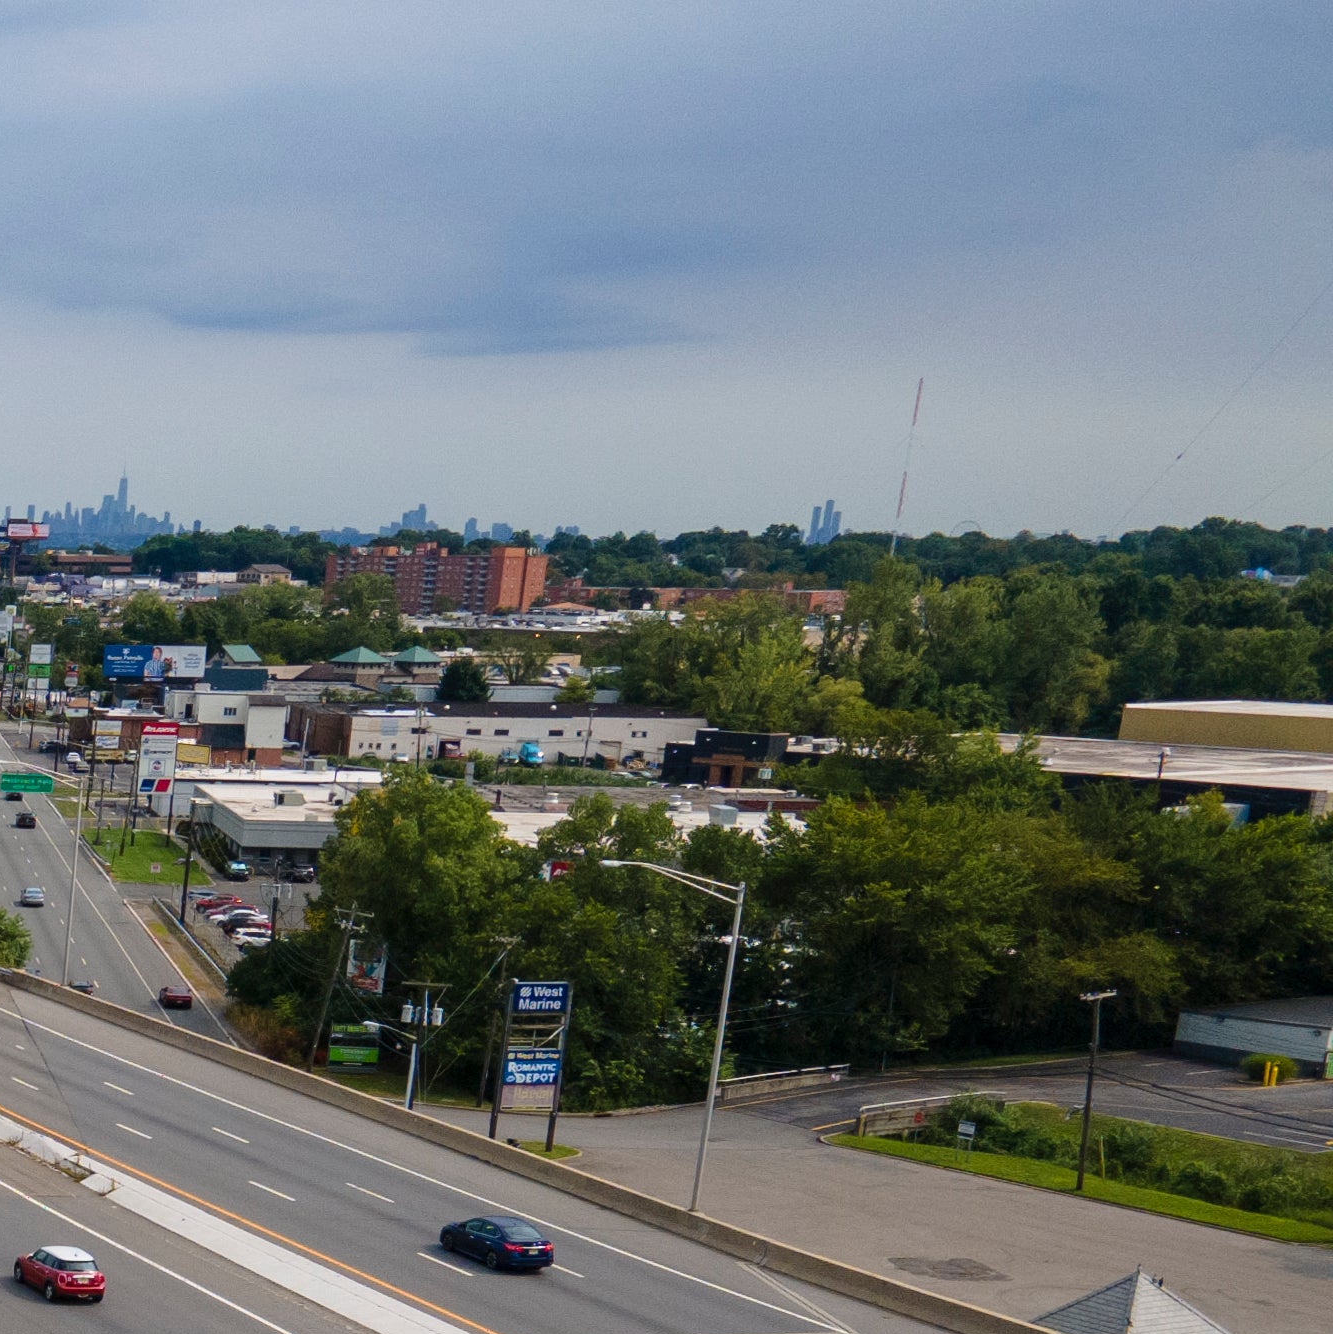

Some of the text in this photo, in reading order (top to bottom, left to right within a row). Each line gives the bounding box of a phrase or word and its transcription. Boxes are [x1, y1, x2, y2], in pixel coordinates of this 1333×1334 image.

[533, 986, 563, 997] West
[518, 998, 562, 1010] Marine
[514, 1072, 556, 1084] DEPOT
